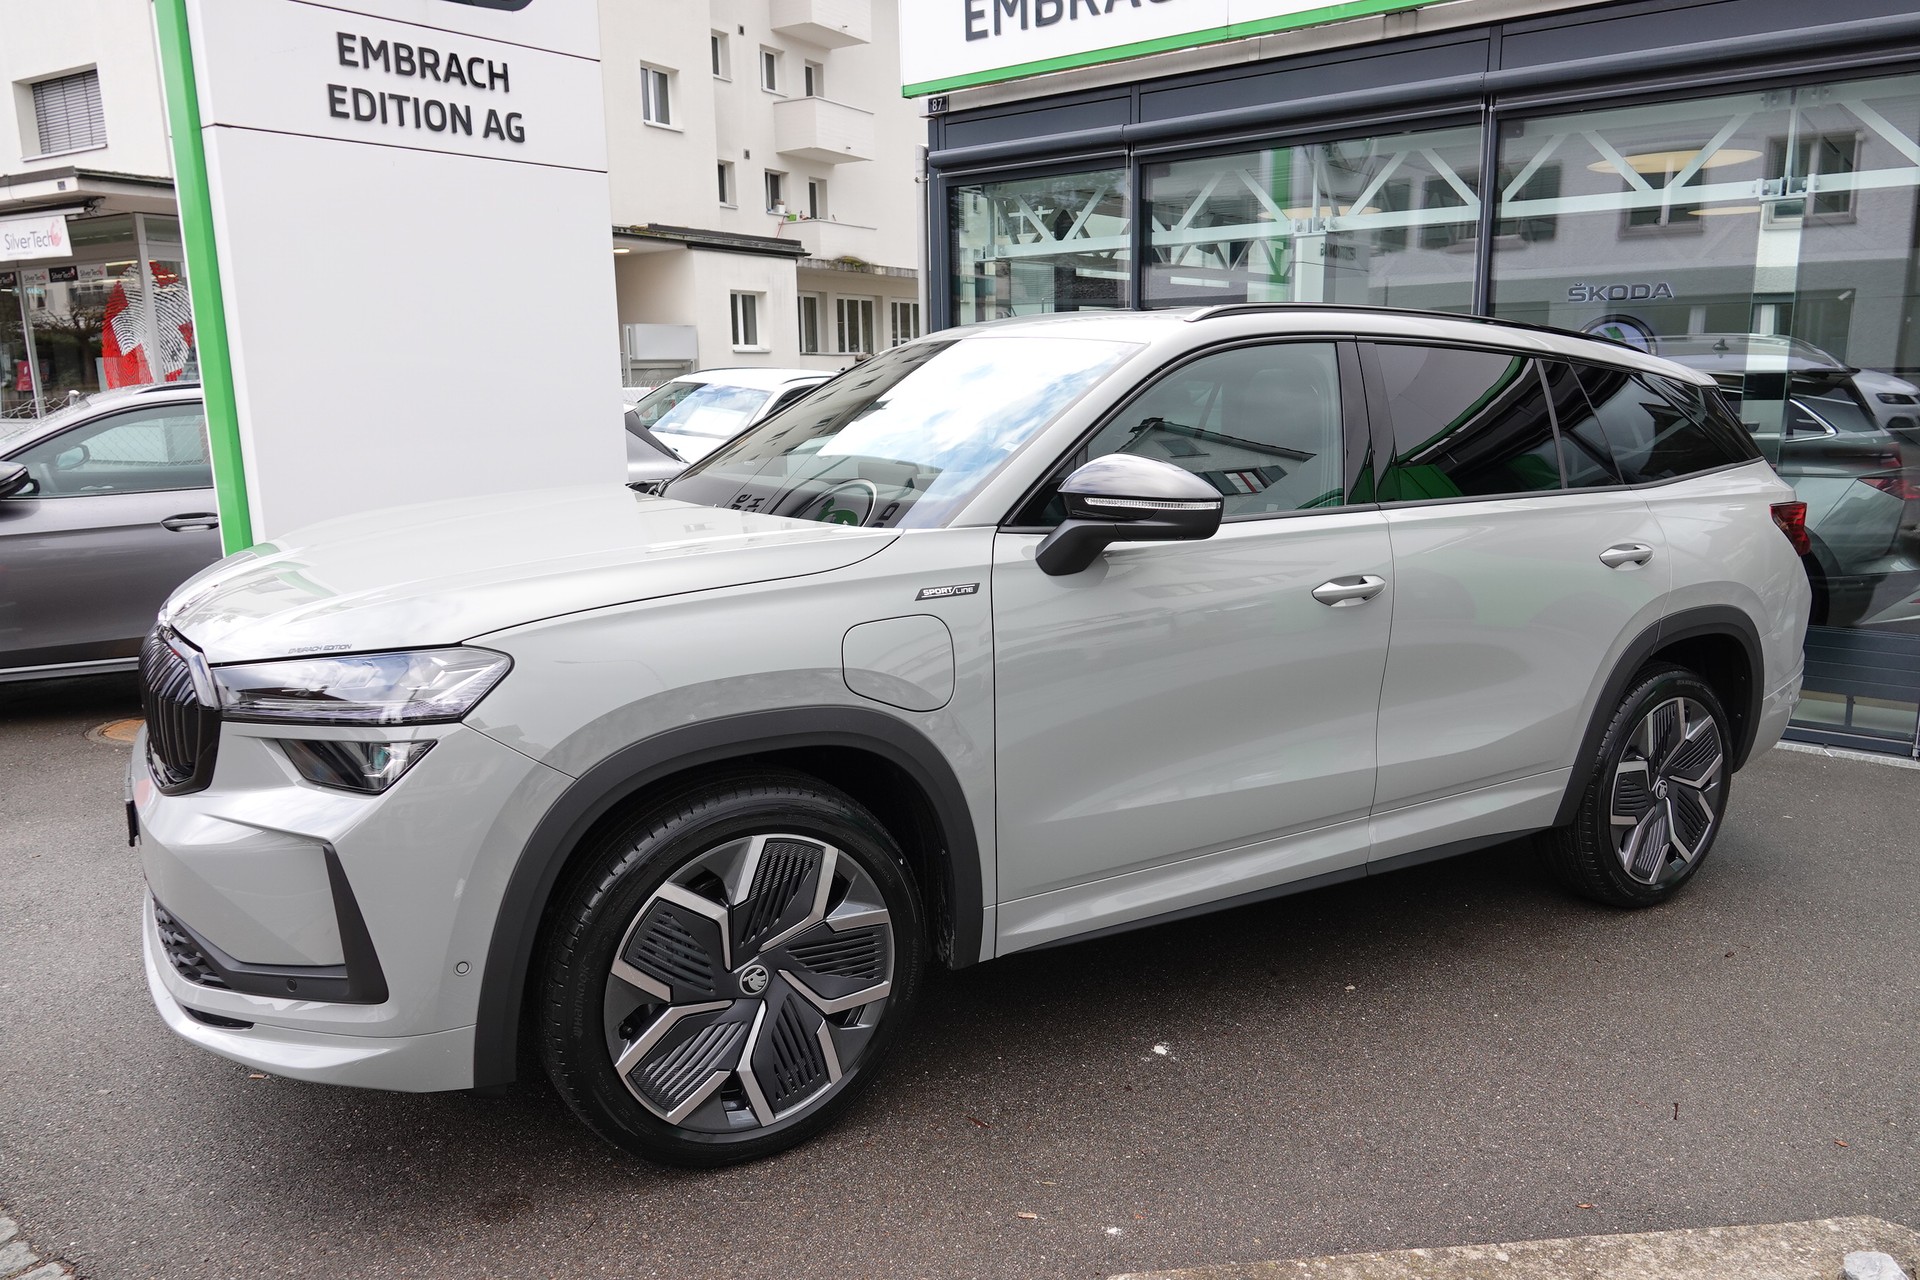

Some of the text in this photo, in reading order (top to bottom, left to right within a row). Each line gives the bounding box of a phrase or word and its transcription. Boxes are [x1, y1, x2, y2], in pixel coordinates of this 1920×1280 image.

[336, 31, 510, 93] EMBRACH
[327, 83, 525, 144] EDITION AG
[932, 97, 943, 112] 87
[4, 230, 54, 251] SilverTech
[1567, 282, 1674, 302] ŠKODA
